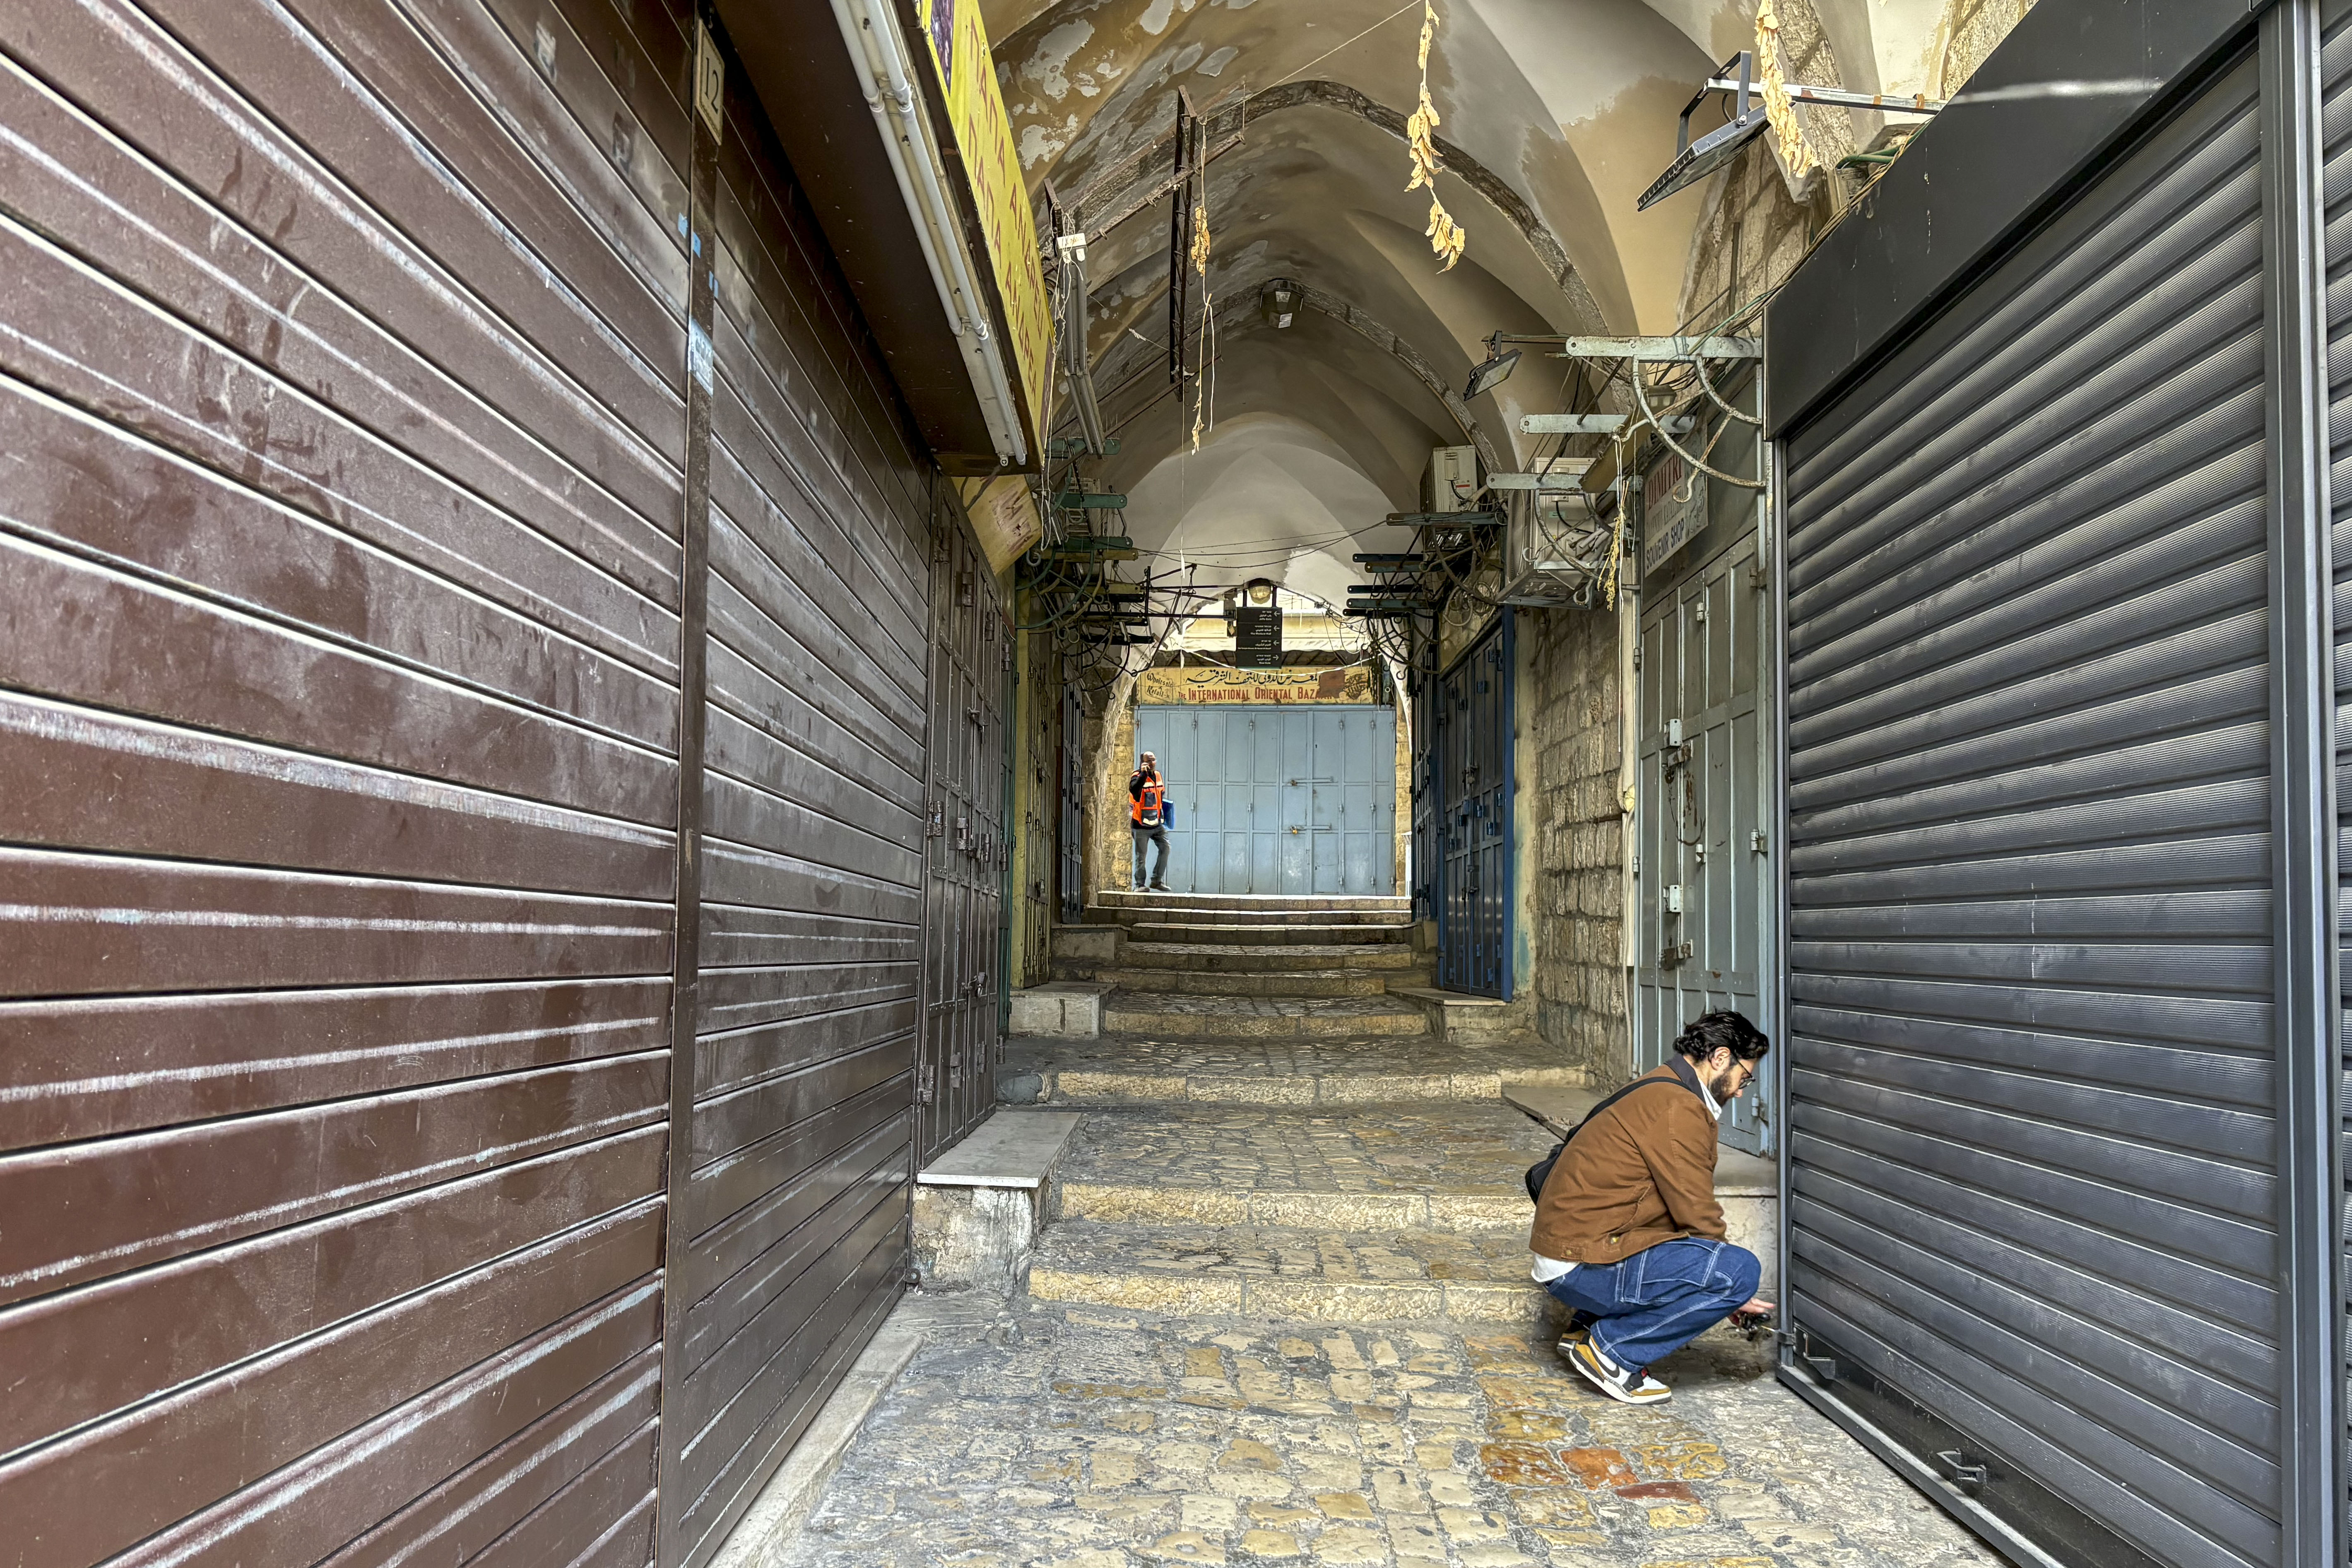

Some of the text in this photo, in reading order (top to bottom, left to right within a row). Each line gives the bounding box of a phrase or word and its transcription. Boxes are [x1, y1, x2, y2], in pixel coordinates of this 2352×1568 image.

[705, 57, 719, 114] 12
[1646, 532, 1669, 570] SOUVENIR
[1671, 518, 1684, 549] SHOP
[1147, 672, 1172, 687] Wholesale
[1178, 691, 1187, 699] THE
[1188, 688, 1250, 700] INTERNATIONAL
[1254, 687, 1293, 700] ORIENTAL
